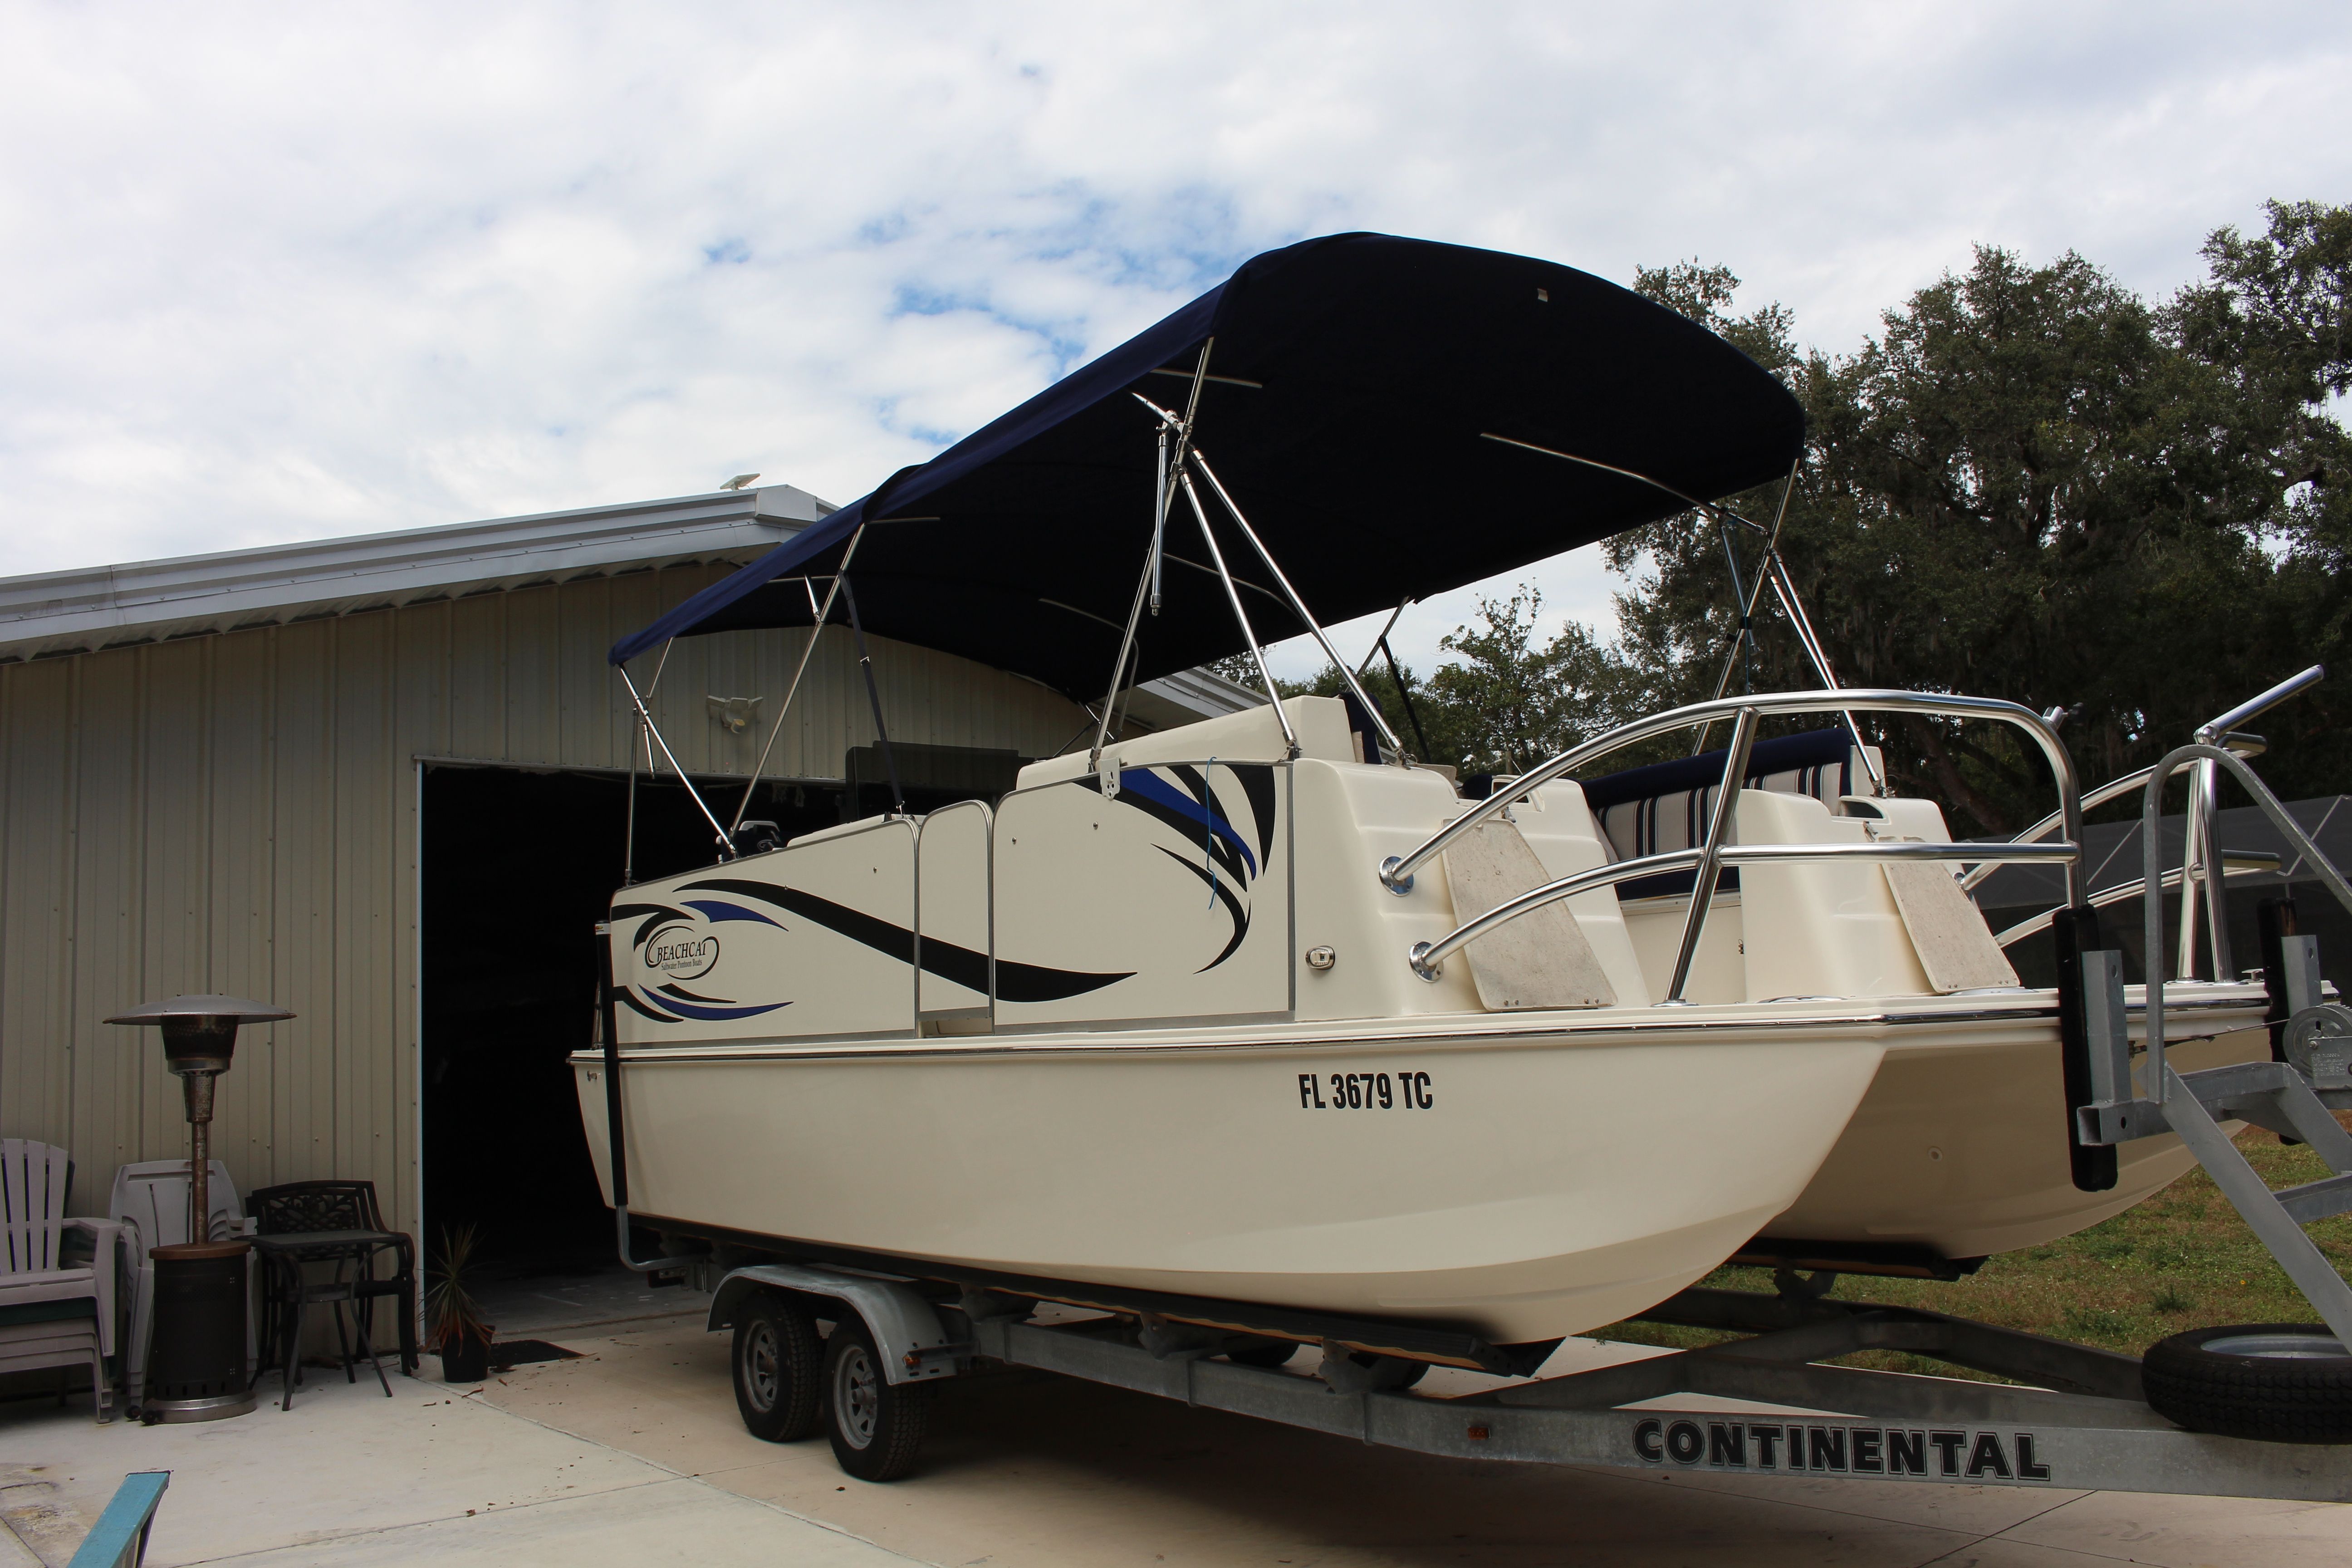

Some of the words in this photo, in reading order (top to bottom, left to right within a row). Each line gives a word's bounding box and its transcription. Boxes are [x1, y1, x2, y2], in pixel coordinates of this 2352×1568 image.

[657, 941, 706, 963] BEACHCAT
[661, 961, 677, 970] Saltwater
[677, 960, 692, 969] Pontoon
[1298, 1073, 1326, 1109] FL
[1330, 1073, 1393, 1109] 3679
[1398, 1071, 1433, 1109] TC
[1632, 1418, 2051, 1481] CONTINENTAL
